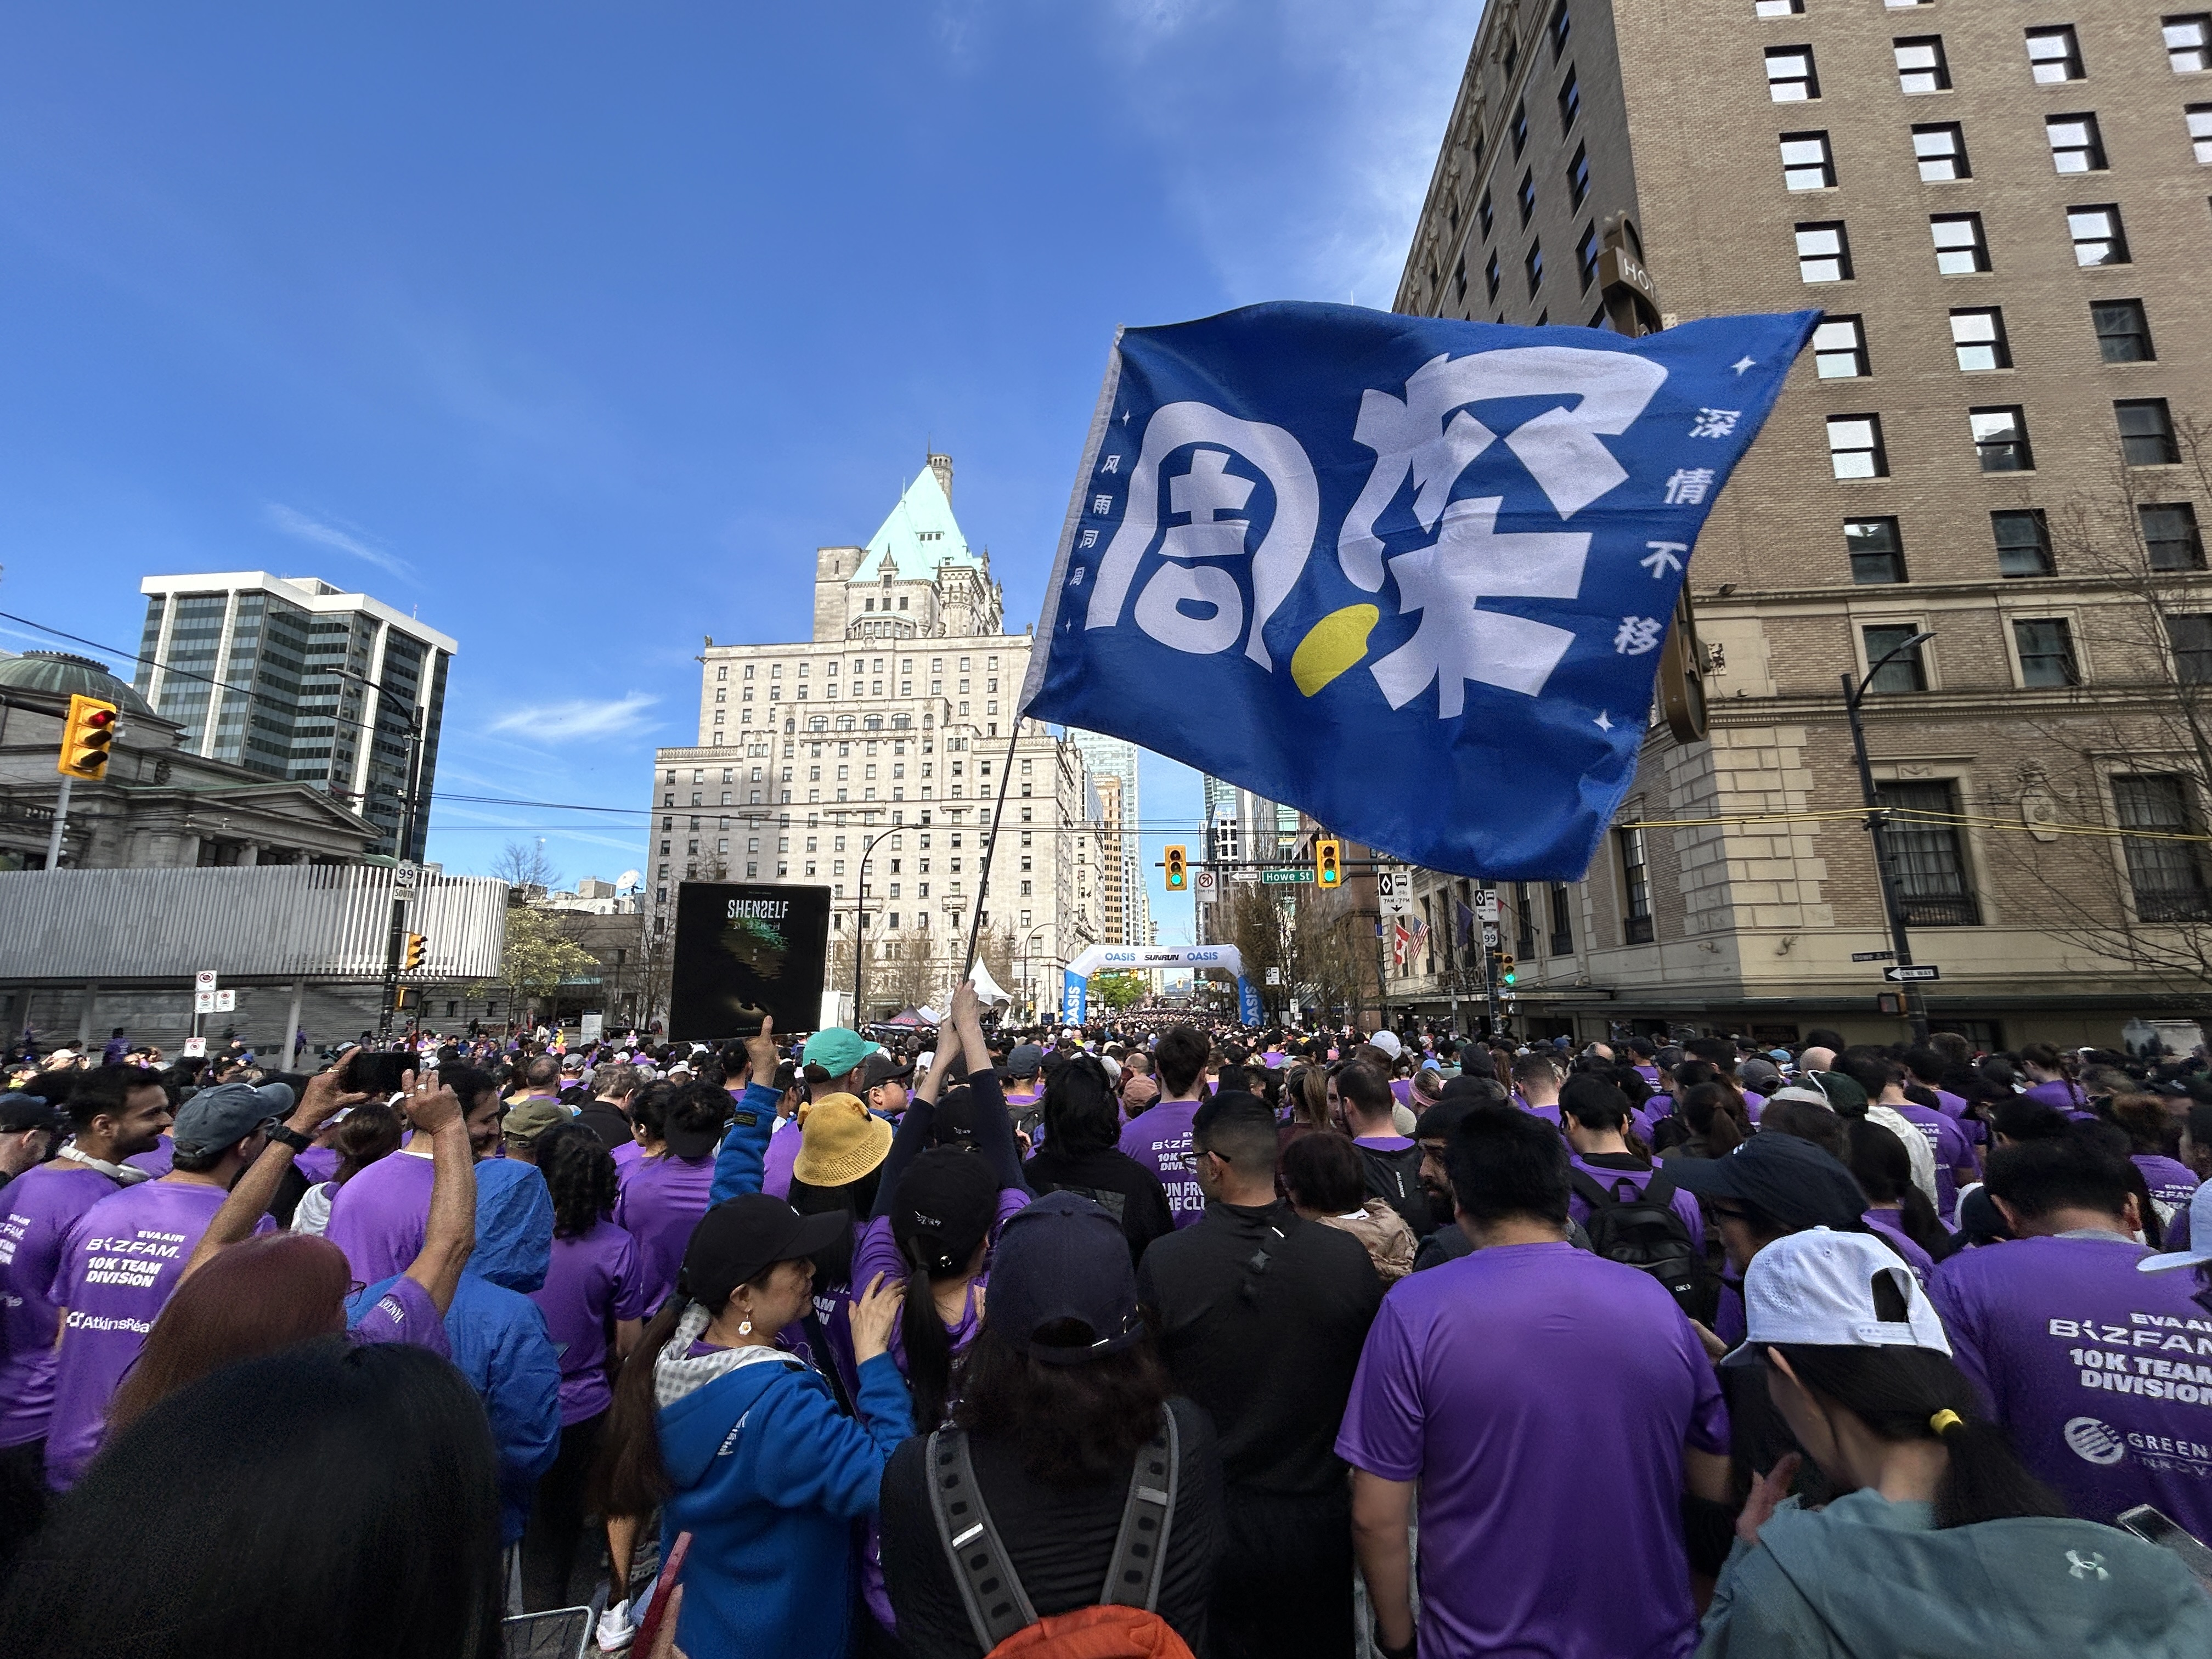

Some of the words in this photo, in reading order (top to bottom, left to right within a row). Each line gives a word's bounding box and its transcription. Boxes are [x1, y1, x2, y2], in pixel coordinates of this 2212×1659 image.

[1069, 454, 1121, 586] 风雨同周
[1613, 407, 1742, 656] 深情不移
[399, 868, 413, 879] 99
[1266, 873, 1295, 881] Howe
[394, 889, 414, 898] SOUTH
[727, 899, 789, 919] SHENSELF
[1484, 934, 1496, 943] 99
[1104, 952, 1136, 961] OASIS
[1187, 951, 1218, 961] OASIS
[1152, 1139, 1192, 1150] BIZF
[1158, 1153, 1178, 1162] 10K
[1162, 1182, 1181, 1197] UN
[1169, 1197, 1181, 1211] HE
[88, 1256, 119, 1270] 10K
[120, 1259, 163, 1274] TEAM
[85, 1269, 155, 1288] DIVISION
[80, 1316, 150, 1334] AtkinsRéa
[2069, 1348, 2128, 1372] 10K
